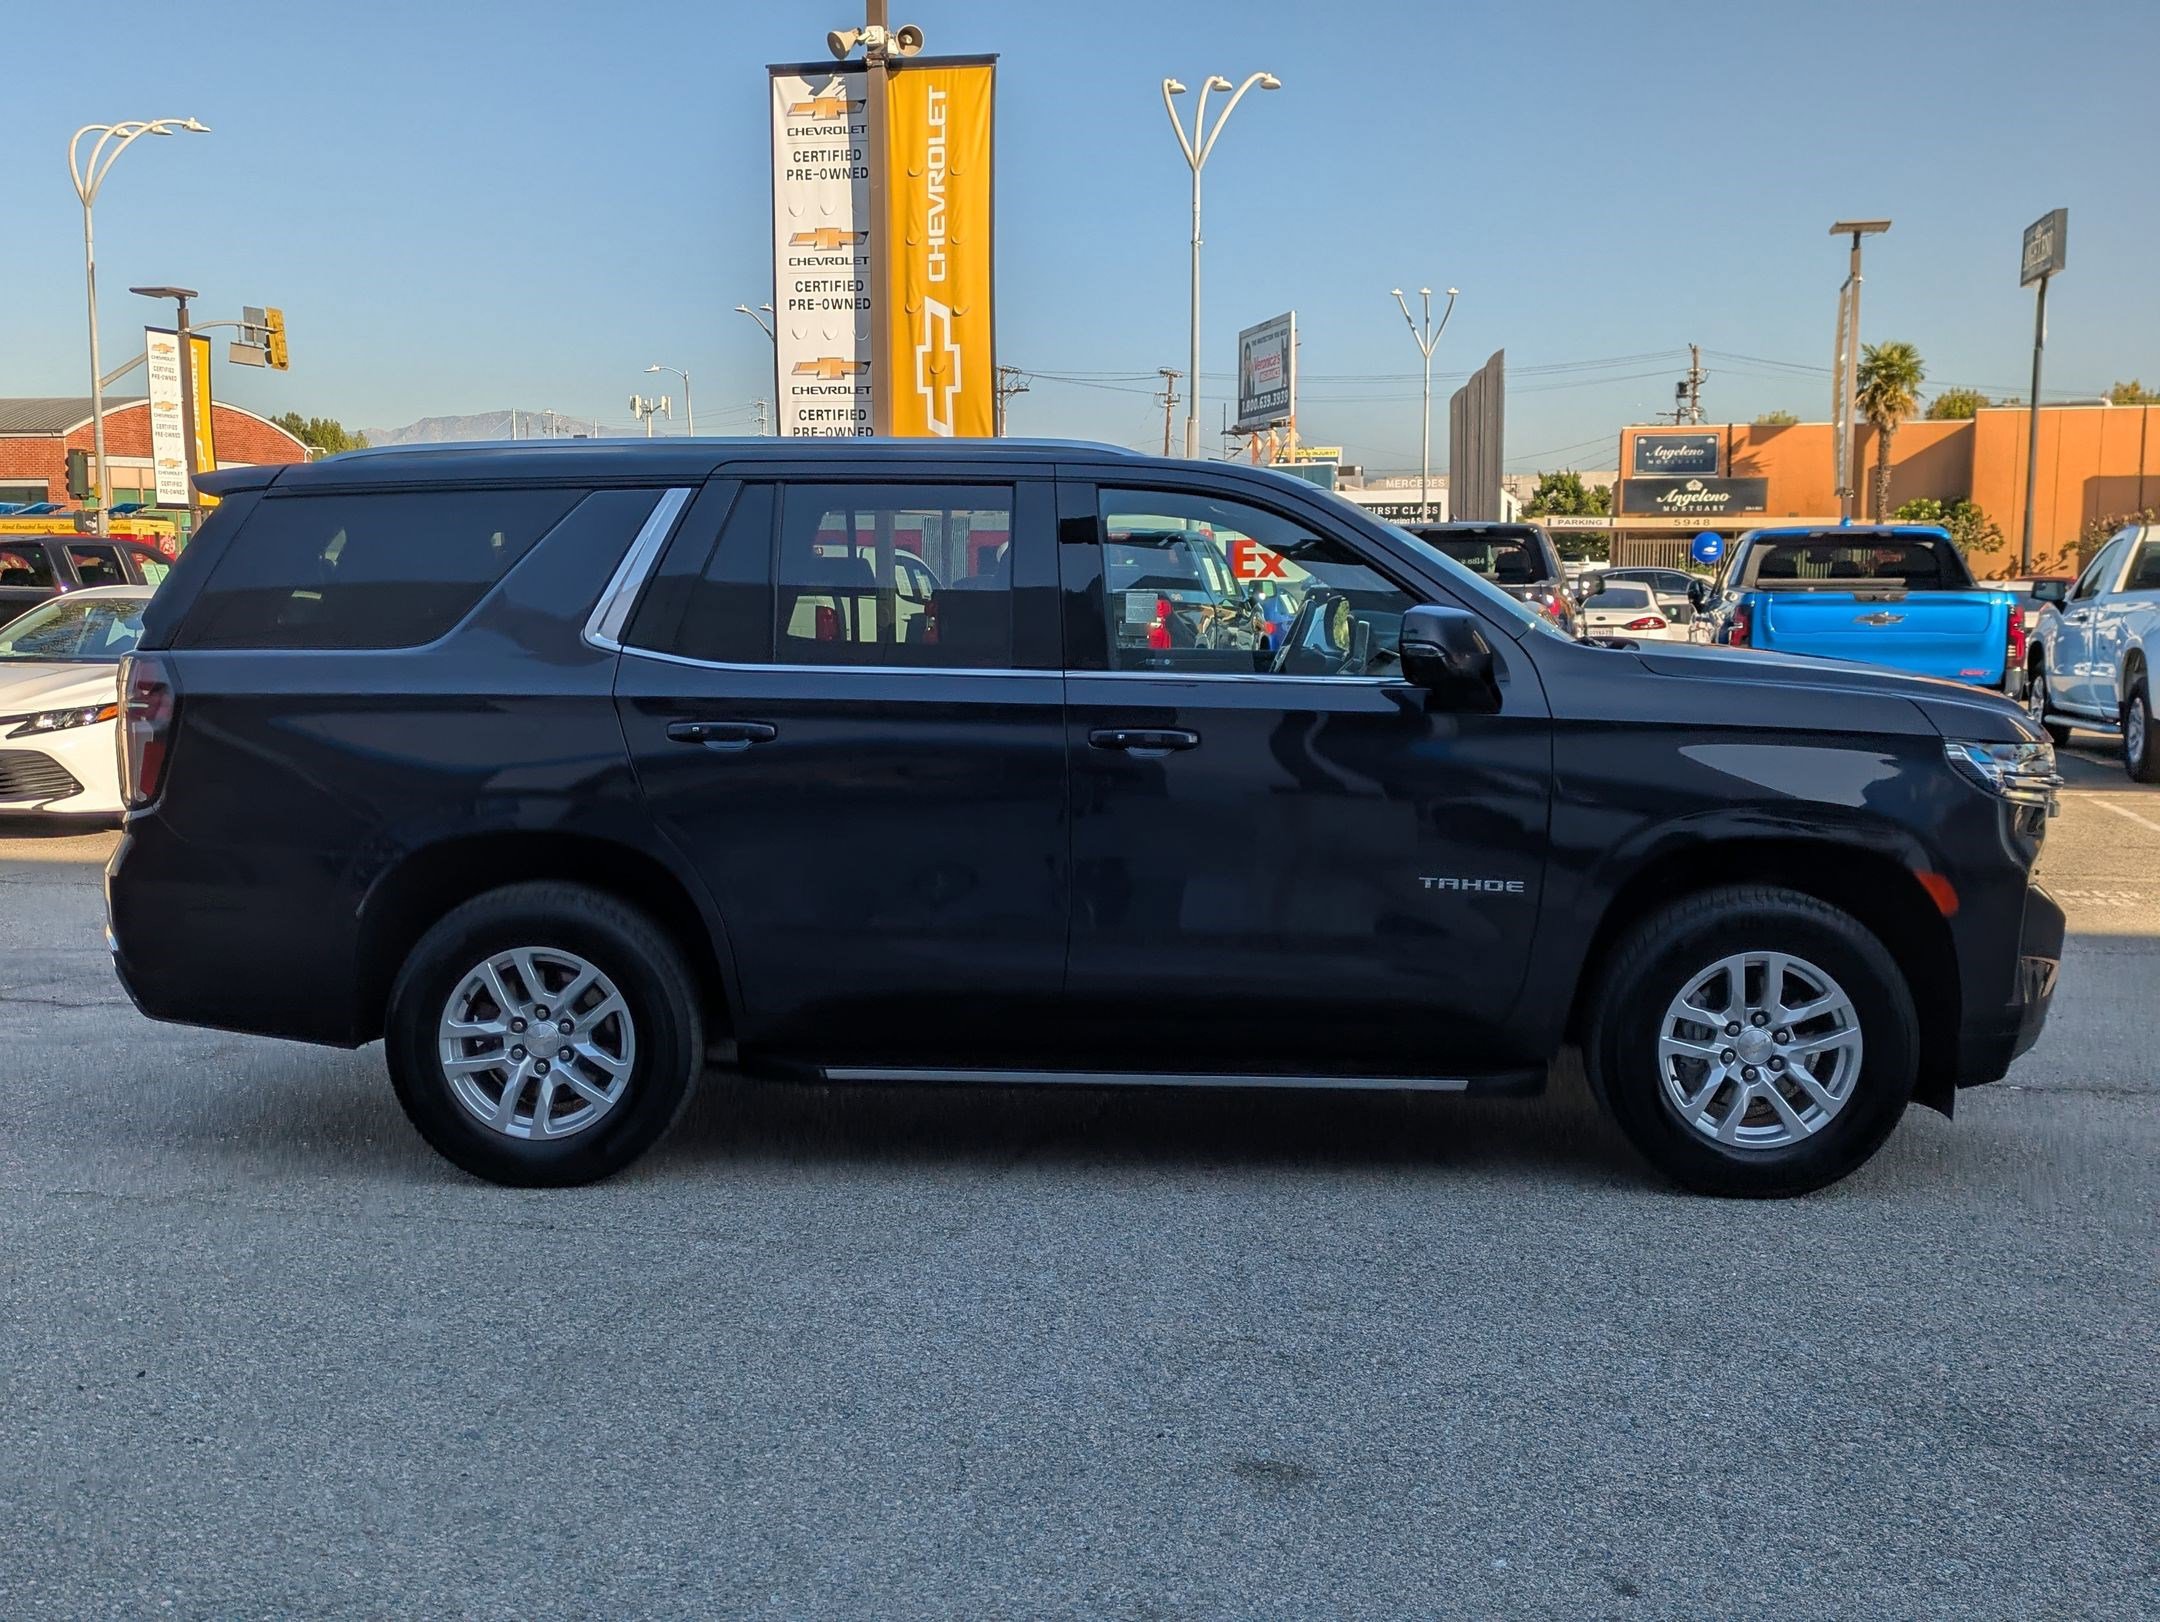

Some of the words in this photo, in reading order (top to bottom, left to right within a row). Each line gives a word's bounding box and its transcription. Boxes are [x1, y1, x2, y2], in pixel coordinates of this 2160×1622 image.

[787, 124, 867, 137] CHEVROLET
[793, 149, 862, 163] CERTIFIED
[786, 167, 869, 181] PRE-OWNED
[928, 85, 948, 282] CHEVROLET
[788, 256, 870, 267] CHEVROLET
[795, 279, 864, 292] CERTIFIED
[788, 298, 871, 311] PRE-OWNED
[792, 386, 872, 396] CHEVROLET
[798, 409, 867, 421] CERTIFIED
[793, 426, 874, 437] PRE-OWNED
[1646, 445, 1704, 460] Angeleno
[1656, 488, 1731, 507] Angeleno
[1365, 506, 1398, 515] FIRST
[1402, 506, 1439, 515] CLASS
[1226, 539, 1289, 578] Ex
[1418, 877, 1525, 893] TAHOE
